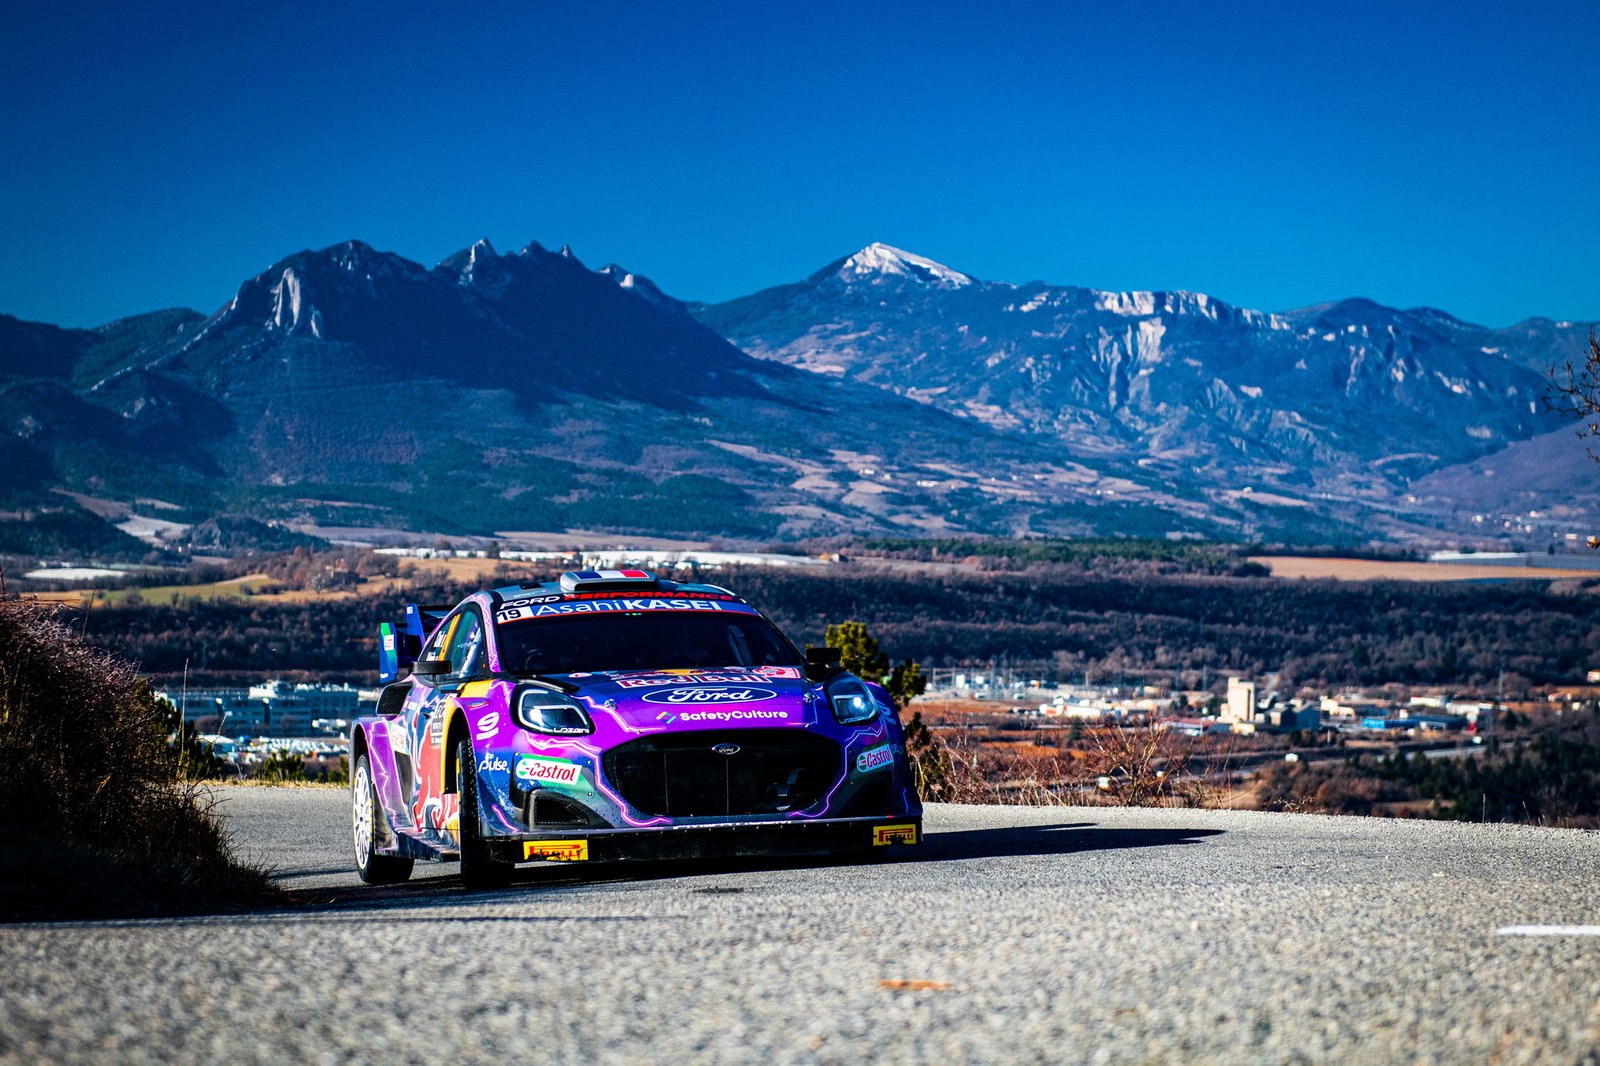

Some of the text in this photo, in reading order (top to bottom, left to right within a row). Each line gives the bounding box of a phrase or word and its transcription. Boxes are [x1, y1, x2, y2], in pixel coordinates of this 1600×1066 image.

[500, 591, 733, 610] FORD PERFORMANCE
[497, 609, 521, 621] 19
[615, 674, 773, 689] Red Bull
[668, 687, 753, 702] Ford
[680, 710, 788, 722] SafetyCulture
[866, 747, 893, 768] Castrol
[529, 762, 576, 782] Castrol
